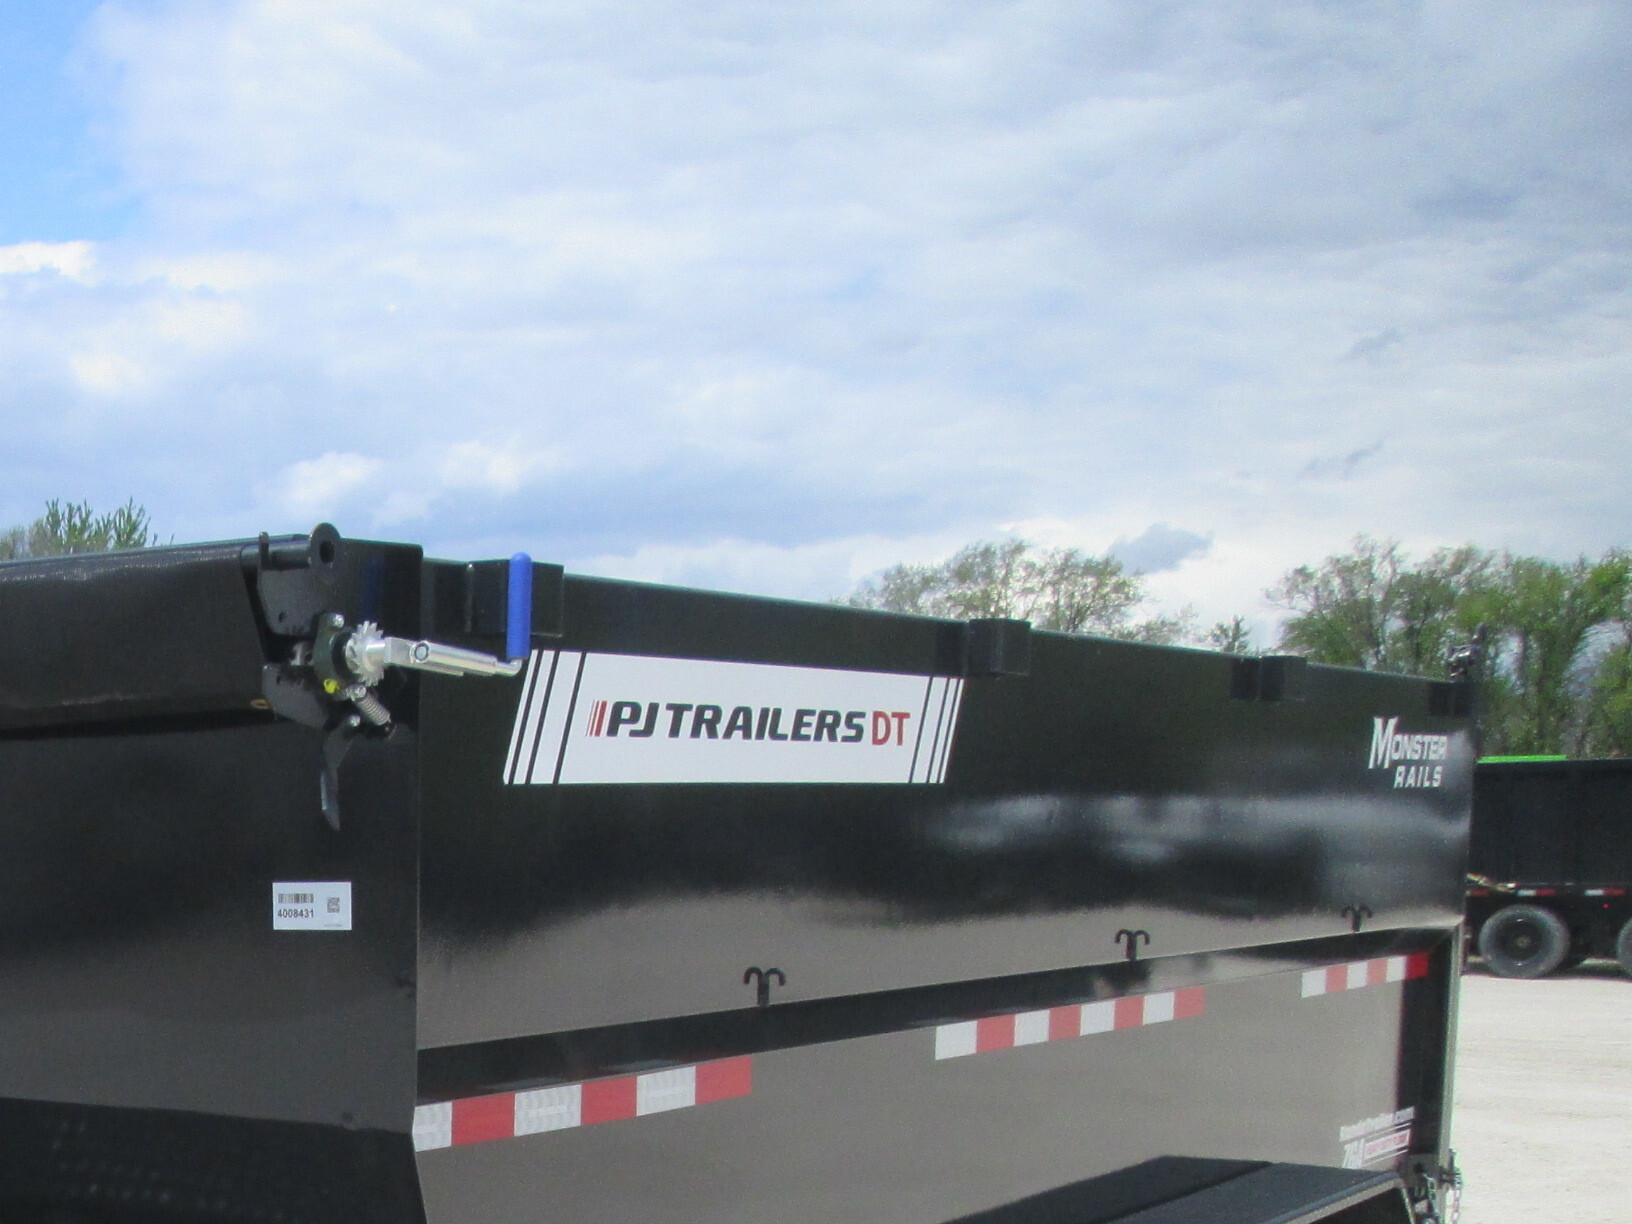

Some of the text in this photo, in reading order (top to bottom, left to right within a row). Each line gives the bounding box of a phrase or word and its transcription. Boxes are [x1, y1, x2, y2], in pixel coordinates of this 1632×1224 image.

[606, 700, 911, 746] PJ TRAILERS DT
[1368, 716, 1448, 769] MONSTER
[1393, 765, 1443, 789] RAILS
[277, 908, 314, 918] 4008431
